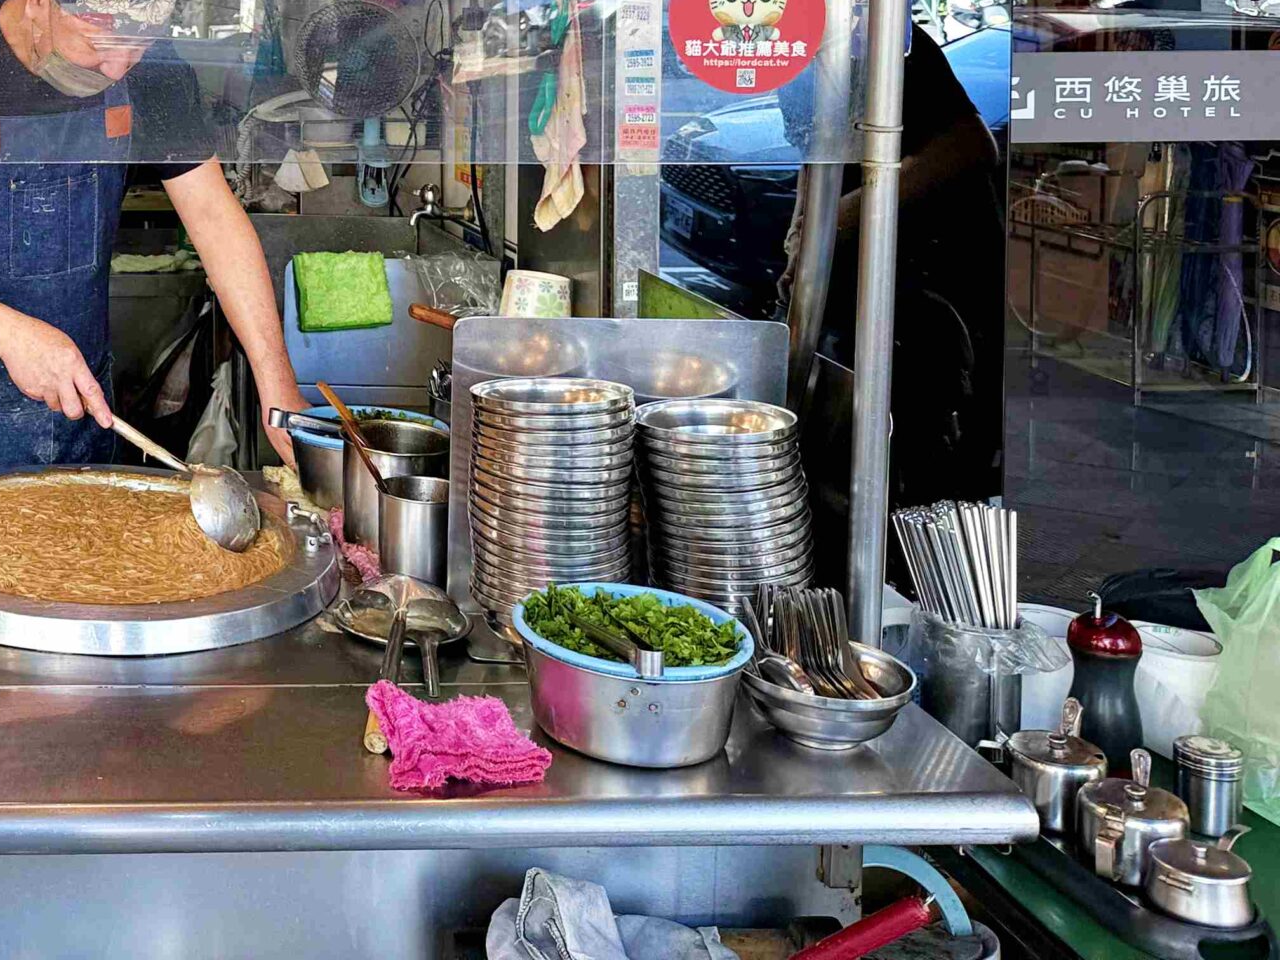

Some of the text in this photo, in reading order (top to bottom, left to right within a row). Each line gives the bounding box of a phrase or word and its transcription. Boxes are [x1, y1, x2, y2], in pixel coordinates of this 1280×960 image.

[685, 40, 808, 58] 貓大爺推薦美食
[703, 58, 790, 67] https://lordcat.tw
[1054, 75, 1241, 103] 西悠巢旅
[1054, 107, 1241, 119] CU HOTEL
